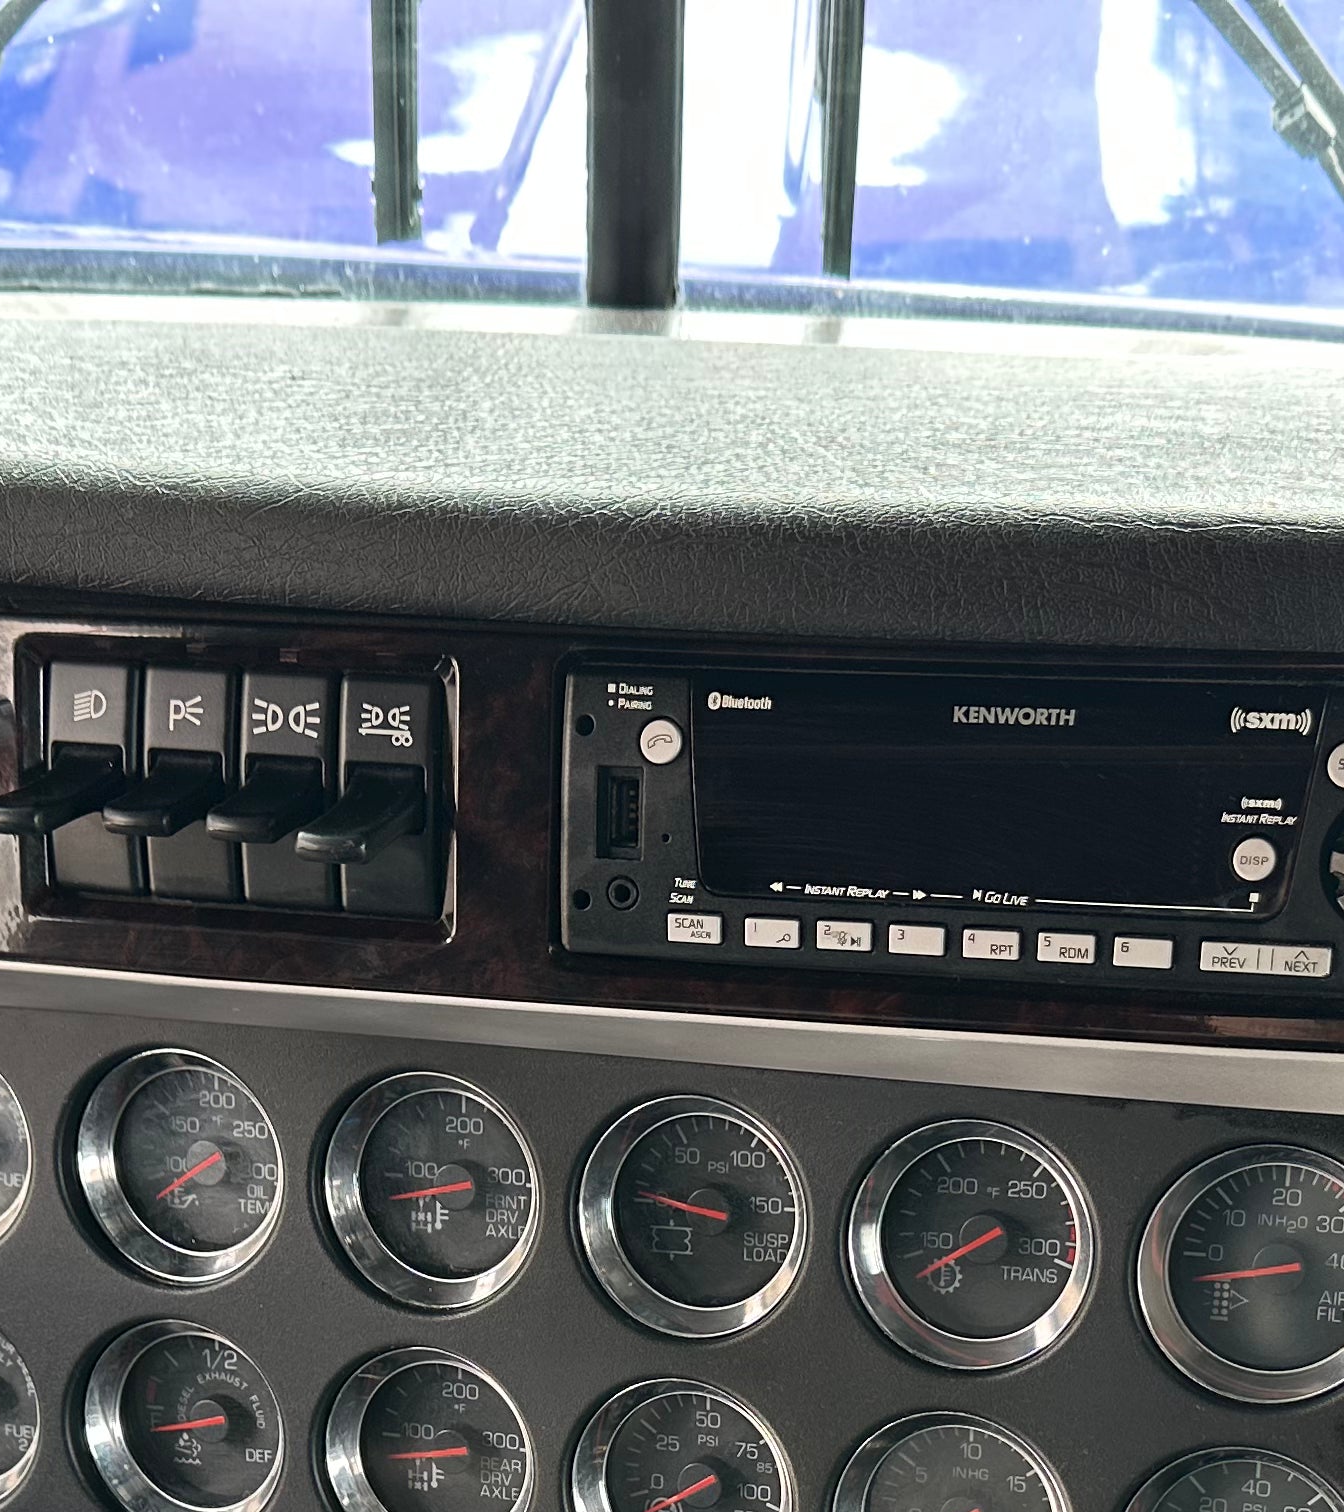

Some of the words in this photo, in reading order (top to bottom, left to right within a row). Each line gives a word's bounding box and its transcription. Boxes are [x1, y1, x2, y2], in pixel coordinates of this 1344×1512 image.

[721, 694, 772, 710] Bluetooth
[953, 705, 1076, 726] KENWORTH
[1240, 855, 1269, 866] DISP
[674, 917, 704, 930] SCAN
[897, 929, 905, 940] 3
[968, 933, 975, 944] 4
[1044, 936, 1051, 947] 5
[990, 943, 1014, 957] RPT
[1058, 946, 1089, 960] RDM
[1120, 942, 1129, 953] 6
[1211, 956, 1246, 969] PREV
[1284, 960, 1318, 974] NEXT
[199, 1092, 236, 1110] 200
[170, 1116, 200, 1133] 150
[232, 1121, 269, 1139] 250
[445, 1116, 484, 1135] 200
[674, 1148, 700, 1165] 50
[729, 1150, 766, 1169] 100
[407, 1162, 437, 1179] 100
[707, 1161, 730, 1174] PSI
[487, 1167, 526, 1186] 300
[247, 1184, 269, 1200] OIL
[937, 1176, 978, 1195] 200
[1008, 1181, 1047, 1199] 250
[485, 1194, 527, 1211] FRNT
[749, 1196, 782, 1215] 150
[1272, 1188, 1303, 1207] 20
[485, 1209, 519, 1223] DRV
[1222, 1209, 1246, 1228] 10
[1257, 1213, 1273, 1227] IN
[743, 1232, 788, 1248] SUSP
[921, 1232, 953, 1250] 150
[1018, 1237, 1061, 1257] 300
[743, 1247, 787, 1264] LOAD
[1208, 1244, 1223, 1262] 0
[1001, 1265, 1058, 1284] TRANS
[202, 1349, 238, 1370] 1/2
[441, 1382, 479, 1400] 200
[196, 1370, 249, 1391] EXHAUST
[249, 1394, 266, 1430] FLUID
[695, 1411, 721, 1429] 50
[18, 1438, 29, 1452] 2
[482, 1431, 519, 1449] 300
[656, 1435, 680, 1451] 25
[697, 1434, 719, 1447] PSI
[245, 1447, 273, 1463] DEF
[734, 1442, 758, 1460] 75
[960, 1443, 982, 1460] 10
[480, 1457, 522, 1474] REAR
[756, 1462, 773, 1474] 85
[480, 1471, 512, 1486] DRV
[651, 1473, 664, 1490] 0
[915, 1467, 928, 1483] 5
[738, 1484, 771, 1501] 100
[1007, 1475, 1026, 1493] 15
[1241, 1480, 1271, 1497] 40
[480, 1486, 520, 1501] AXLE
